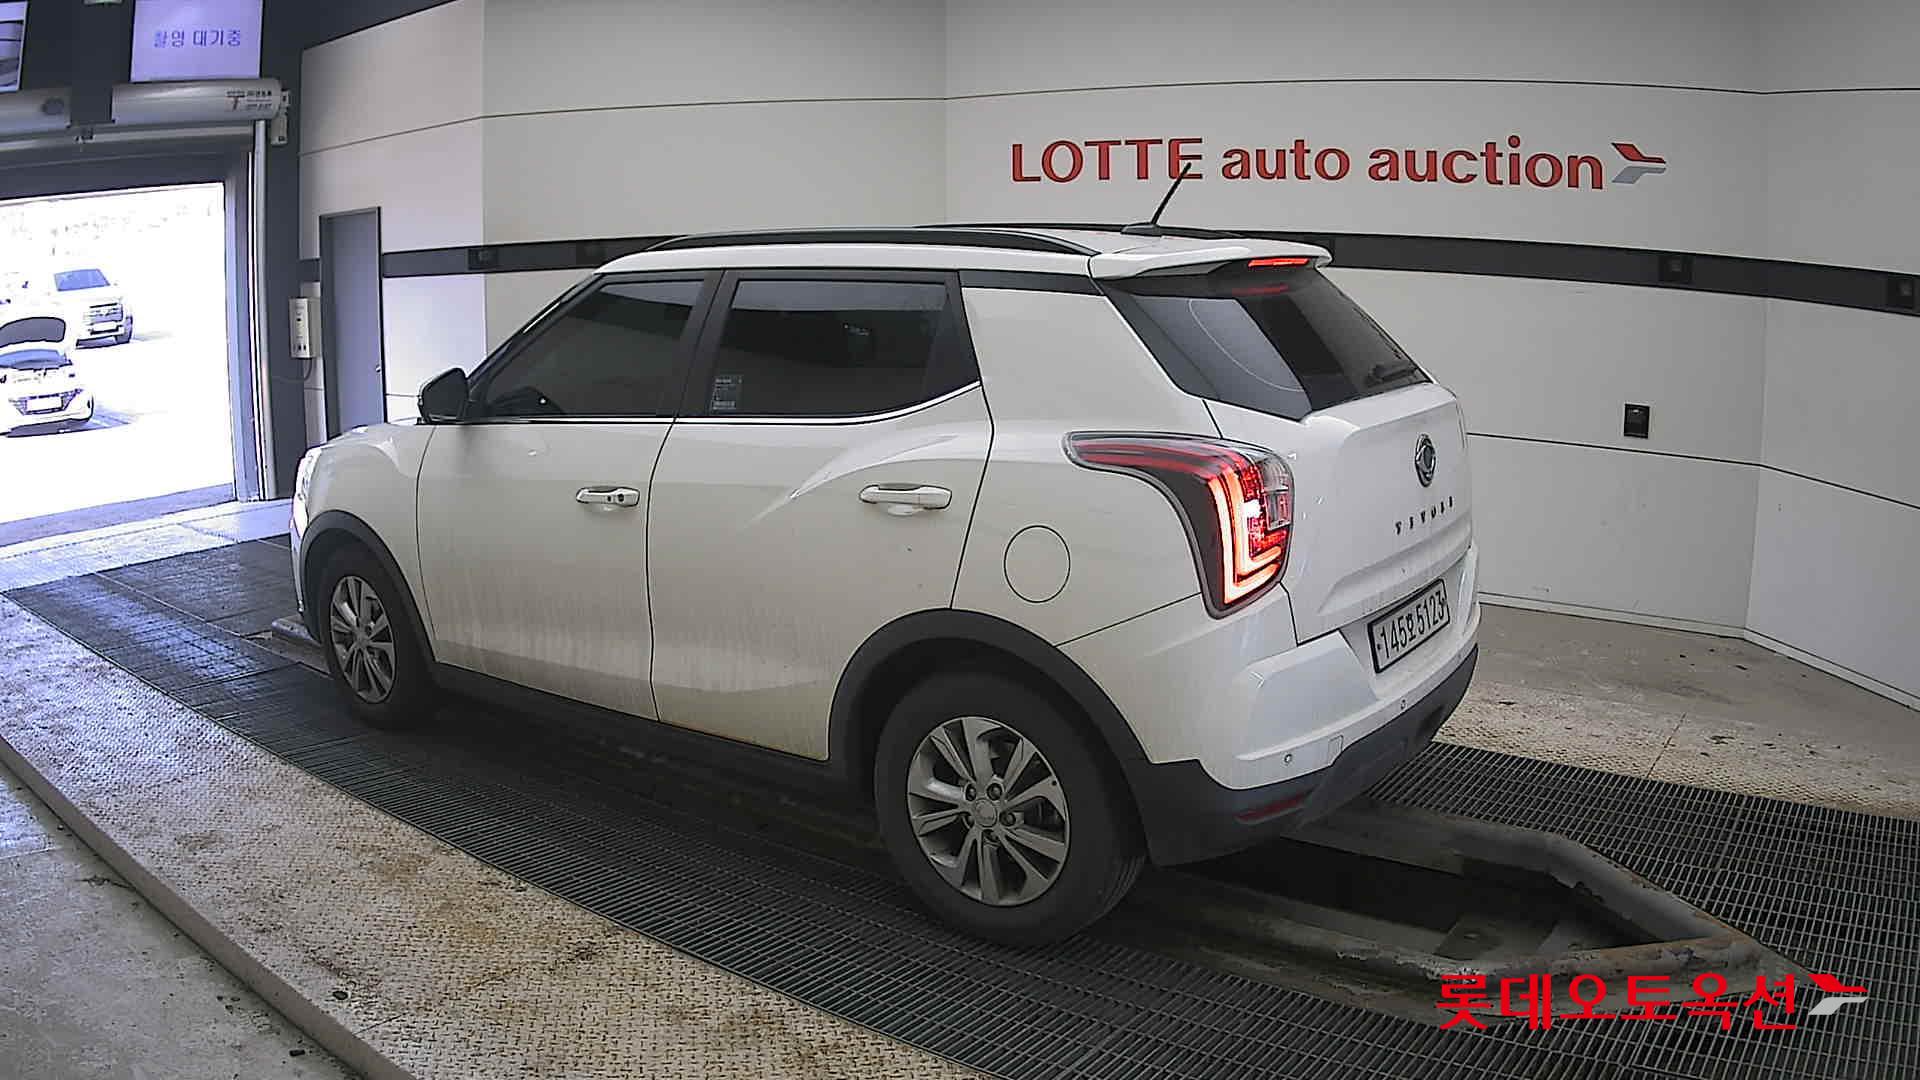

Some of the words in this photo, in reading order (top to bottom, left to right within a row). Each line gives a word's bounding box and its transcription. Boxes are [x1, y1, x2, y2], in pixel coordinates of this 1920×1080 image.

[193, 29, 241, 47] 대기중
[1011, 138, 1203, 183] LOTTE
[1222, 139, 1351, 181] auto
[1368, 136, 1603, 189] auction
